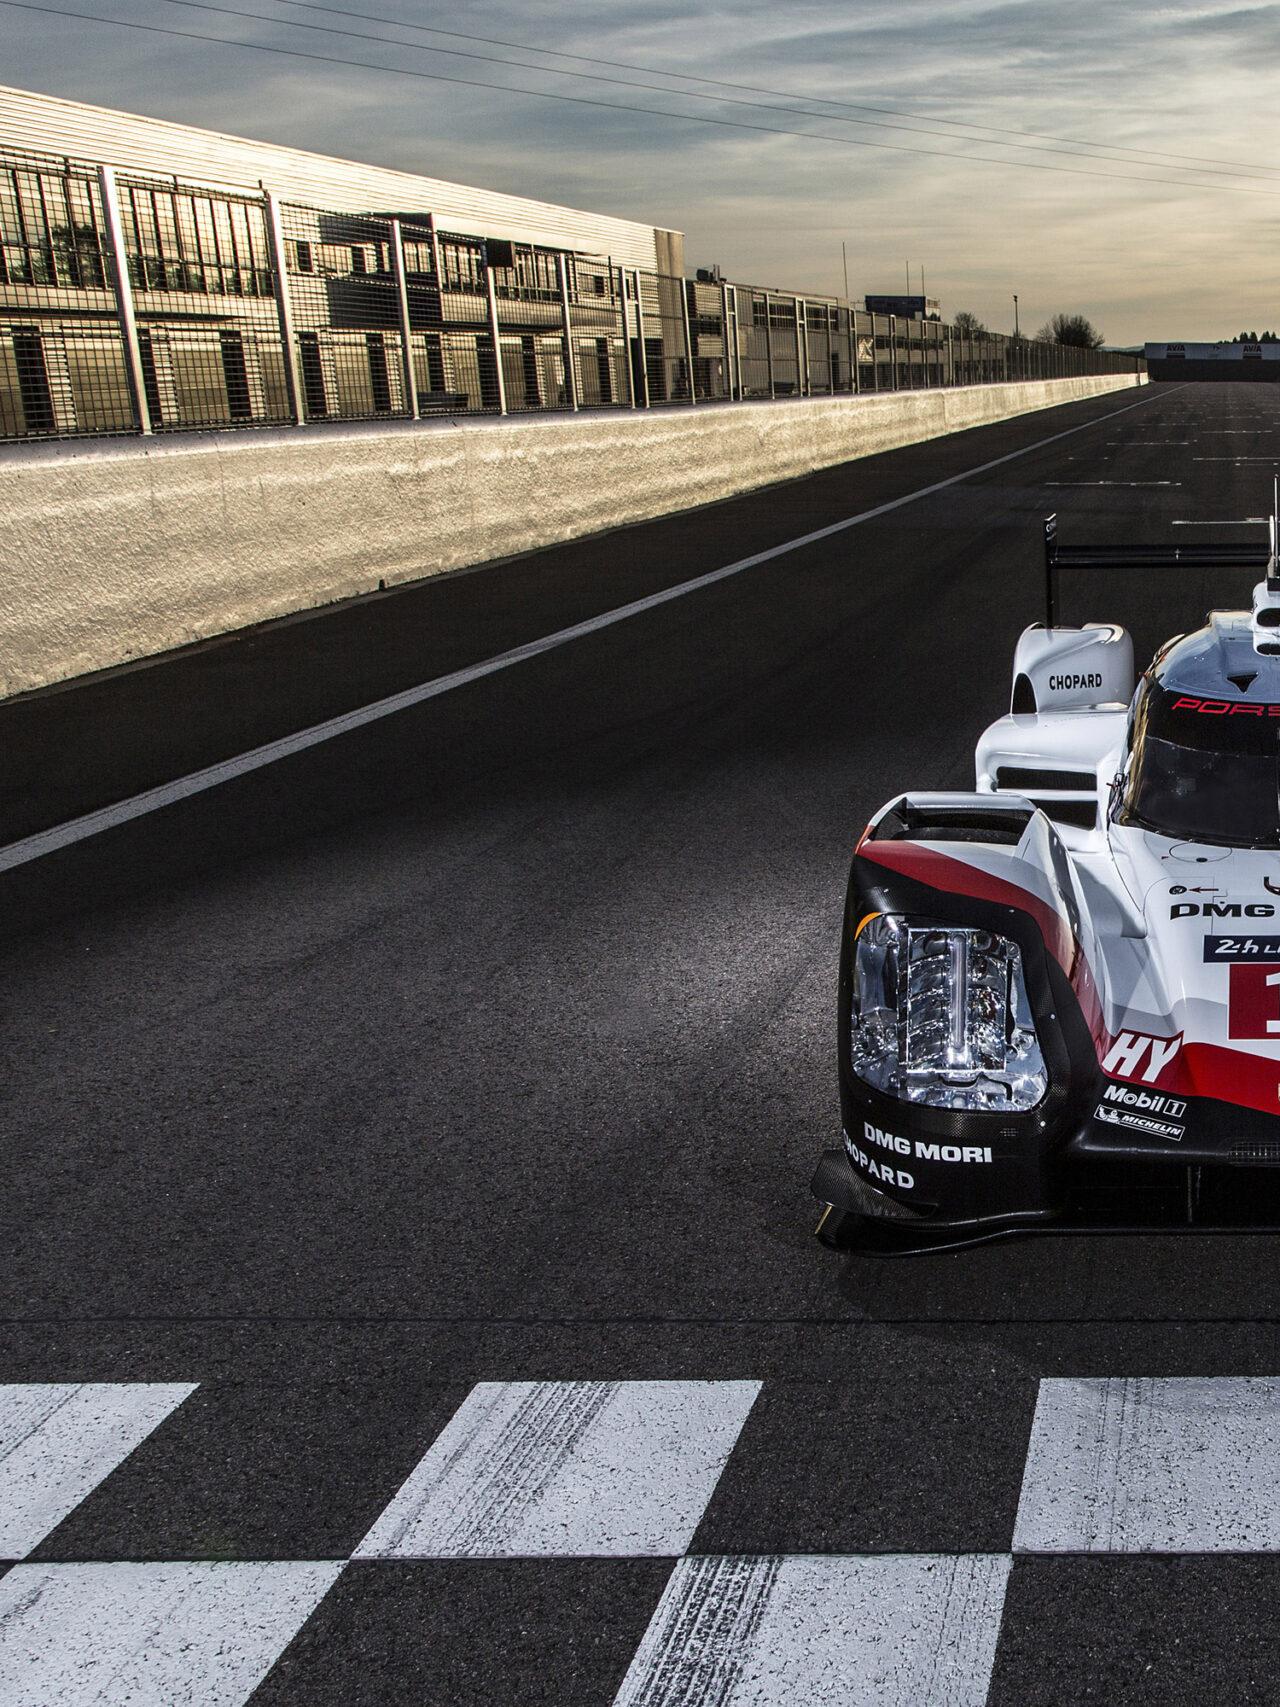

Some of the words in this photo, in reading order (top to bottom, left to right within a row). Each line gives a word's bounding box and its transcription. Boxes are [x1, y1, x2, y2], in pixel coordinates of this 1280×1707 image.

[1049, 673, 1102, 690] CHOPARD
[1170, 903, 1275, 920] DMG
[1101, 1032, 1182, 1083] HY
[1103, 1084, 1166, 1112] Mobil
[1122, 1115, 1181, 1136] MICHELIN
[864, 1121, 911, 1155] DMG
[915, 1141, 993, 1163] MORI
